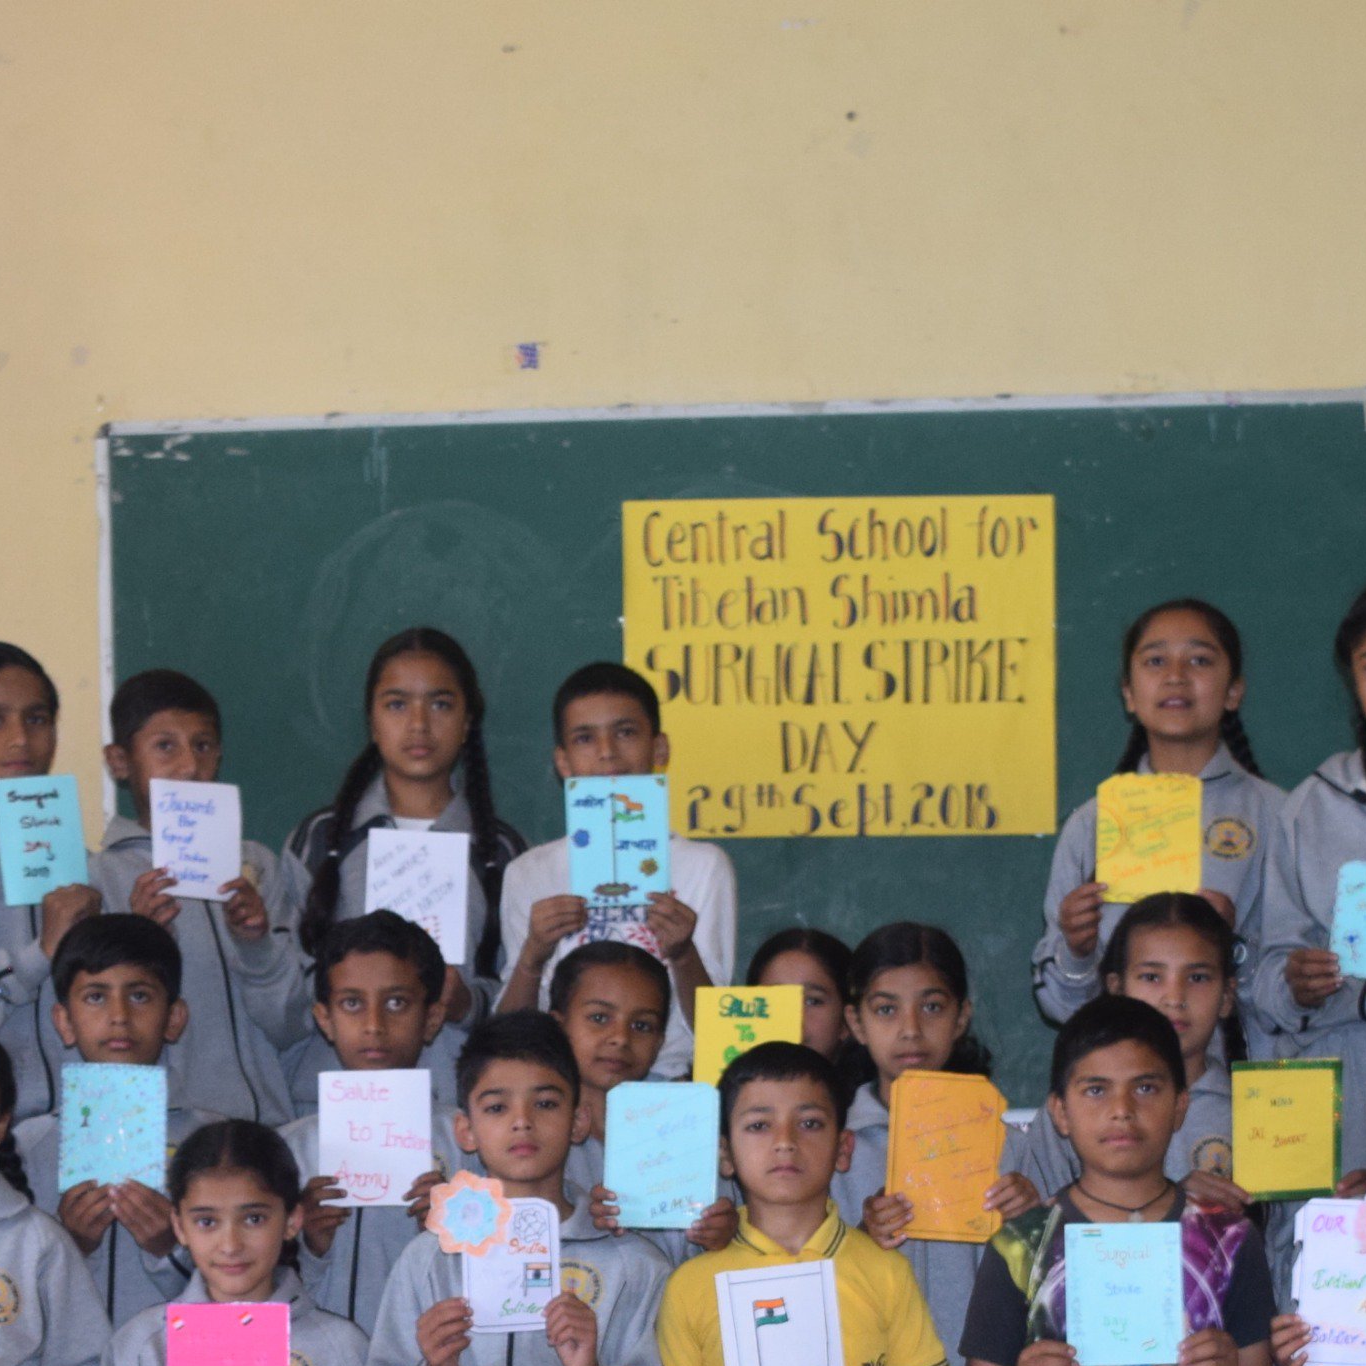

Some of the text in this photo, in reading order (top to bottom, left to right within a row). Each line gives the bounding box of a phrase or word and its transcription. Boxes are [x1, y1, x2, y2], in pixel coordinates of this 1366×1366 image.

[643, 506, 1039, 567] Central School for
[653, 572, 977, 632] Tibetan Shimla
[863, 637, 1030, 705] STRIKE
[1311, 1213, 1348, 1236] OUR
